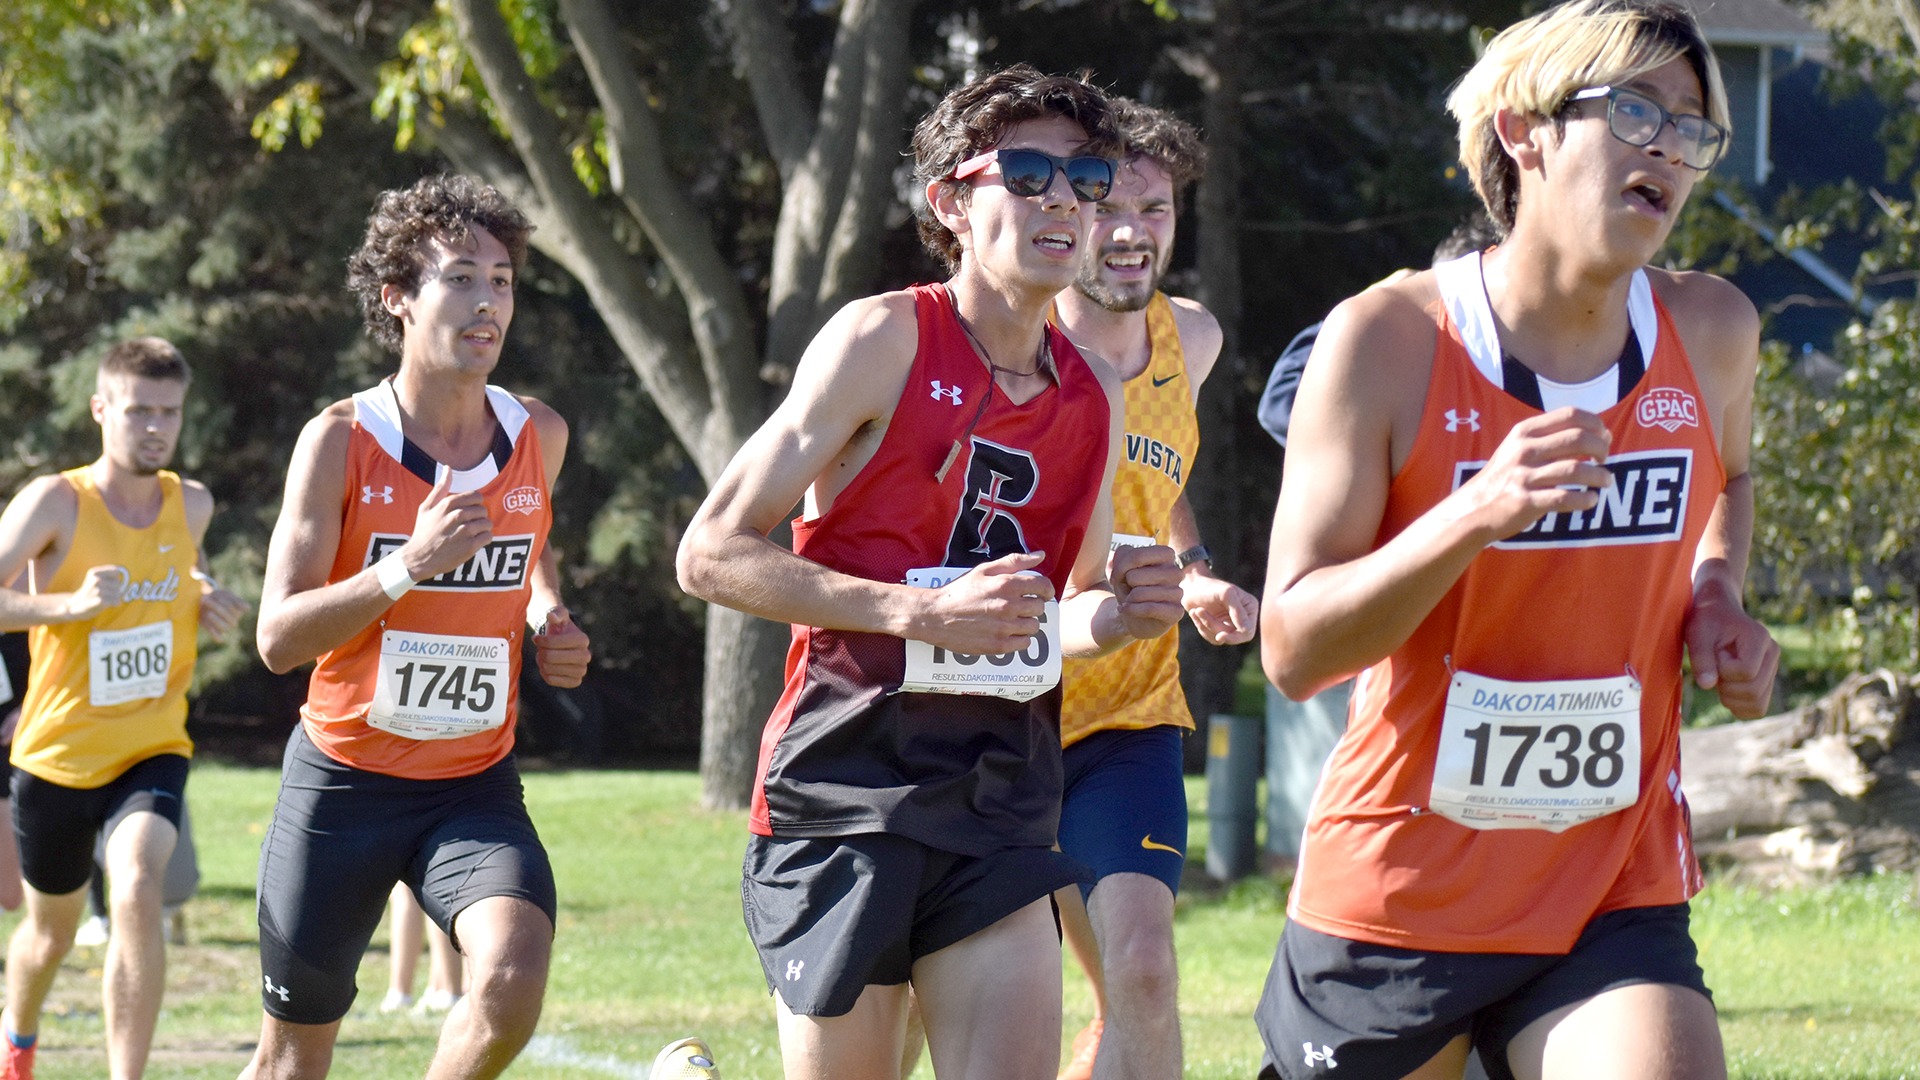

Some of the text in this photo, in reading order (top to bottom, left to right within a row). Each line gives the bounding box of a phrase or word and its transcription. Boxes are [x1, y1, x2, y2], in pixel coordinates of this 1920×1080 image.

[1641, 398, 1696, 422] GPAC
[1125, 432, 1182, 487] VISTA
[101, 643, 168, 682] 1808
[399, 640, 498, 659] DAKOTATIMING
[395, 662, 497, 713] 1745
[932, 673, 1035, 683] RESULTS.DAKOTATIMING.COM
[1472, 688, 1624, 712] DAKOTATIMING
[1464, 722, 1625, 789] 1738
